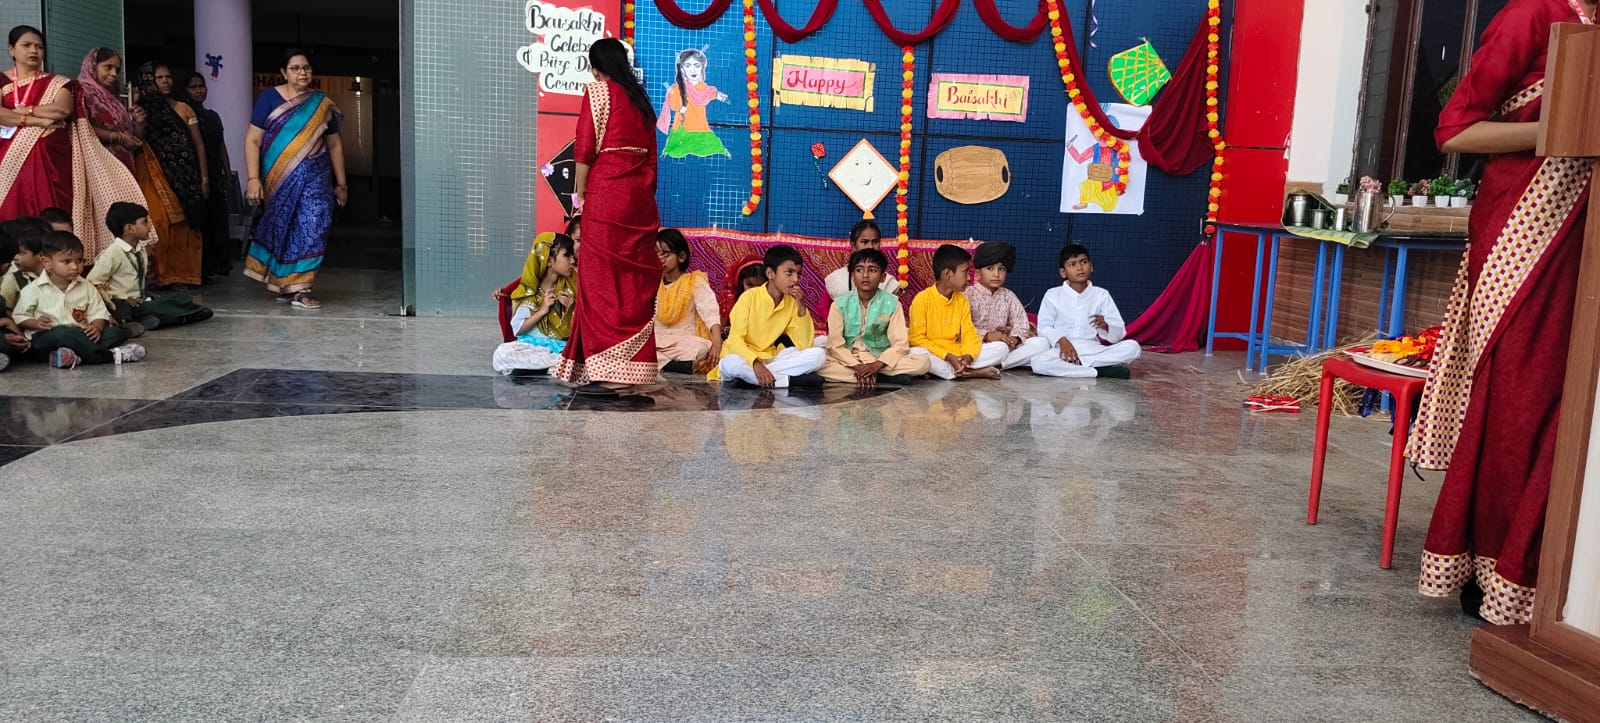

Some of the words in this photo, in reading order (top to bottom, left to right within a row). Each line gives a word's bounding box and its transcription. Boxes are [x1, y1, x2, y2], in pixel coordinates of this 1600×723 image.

[529, 5, 602, 35] Baisakhi
[787, 70, 856, 94] Happy
[947, 86, 1007, 109] Baisakhi
